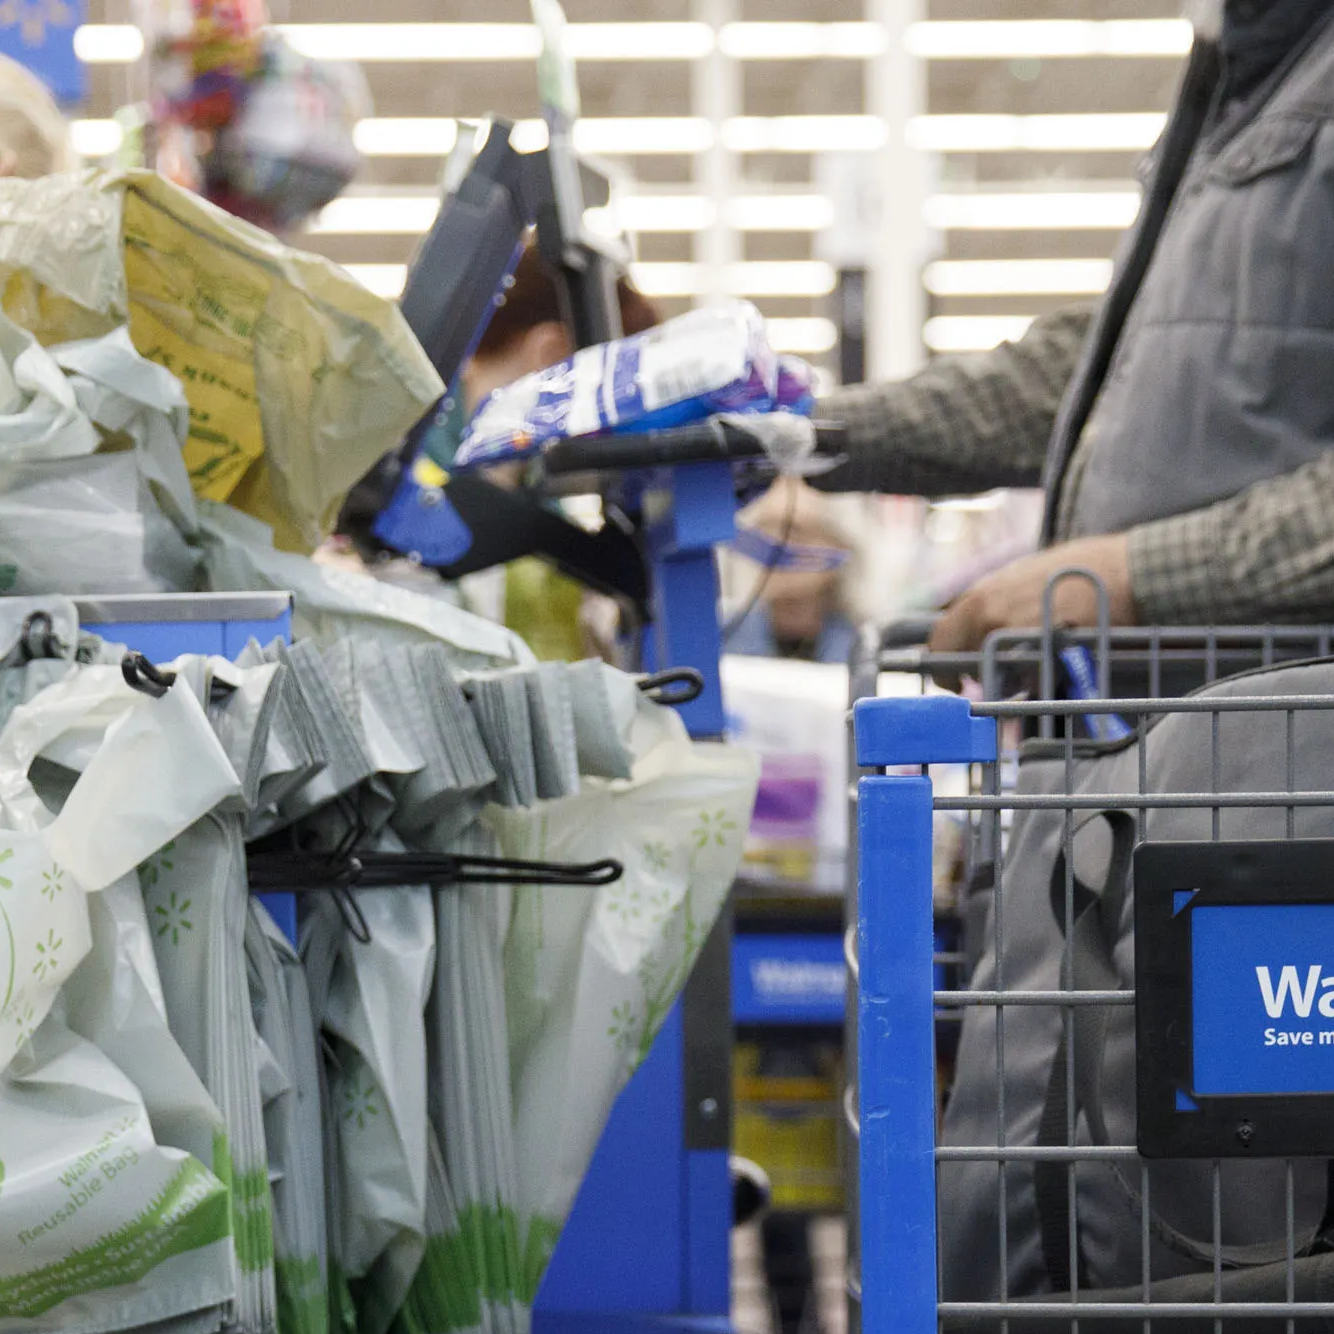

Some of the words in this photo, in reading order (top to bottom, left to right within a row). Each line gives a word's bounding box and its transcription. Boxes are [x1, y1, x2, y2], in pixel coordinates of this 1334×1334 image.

[1264, 1026, 1315, 1046] Save
[58, 1128, 123, 1188] Walmart
[18, 1177, 105, 1246] Reusable
[100, 1145, 140, 1184] Bag
